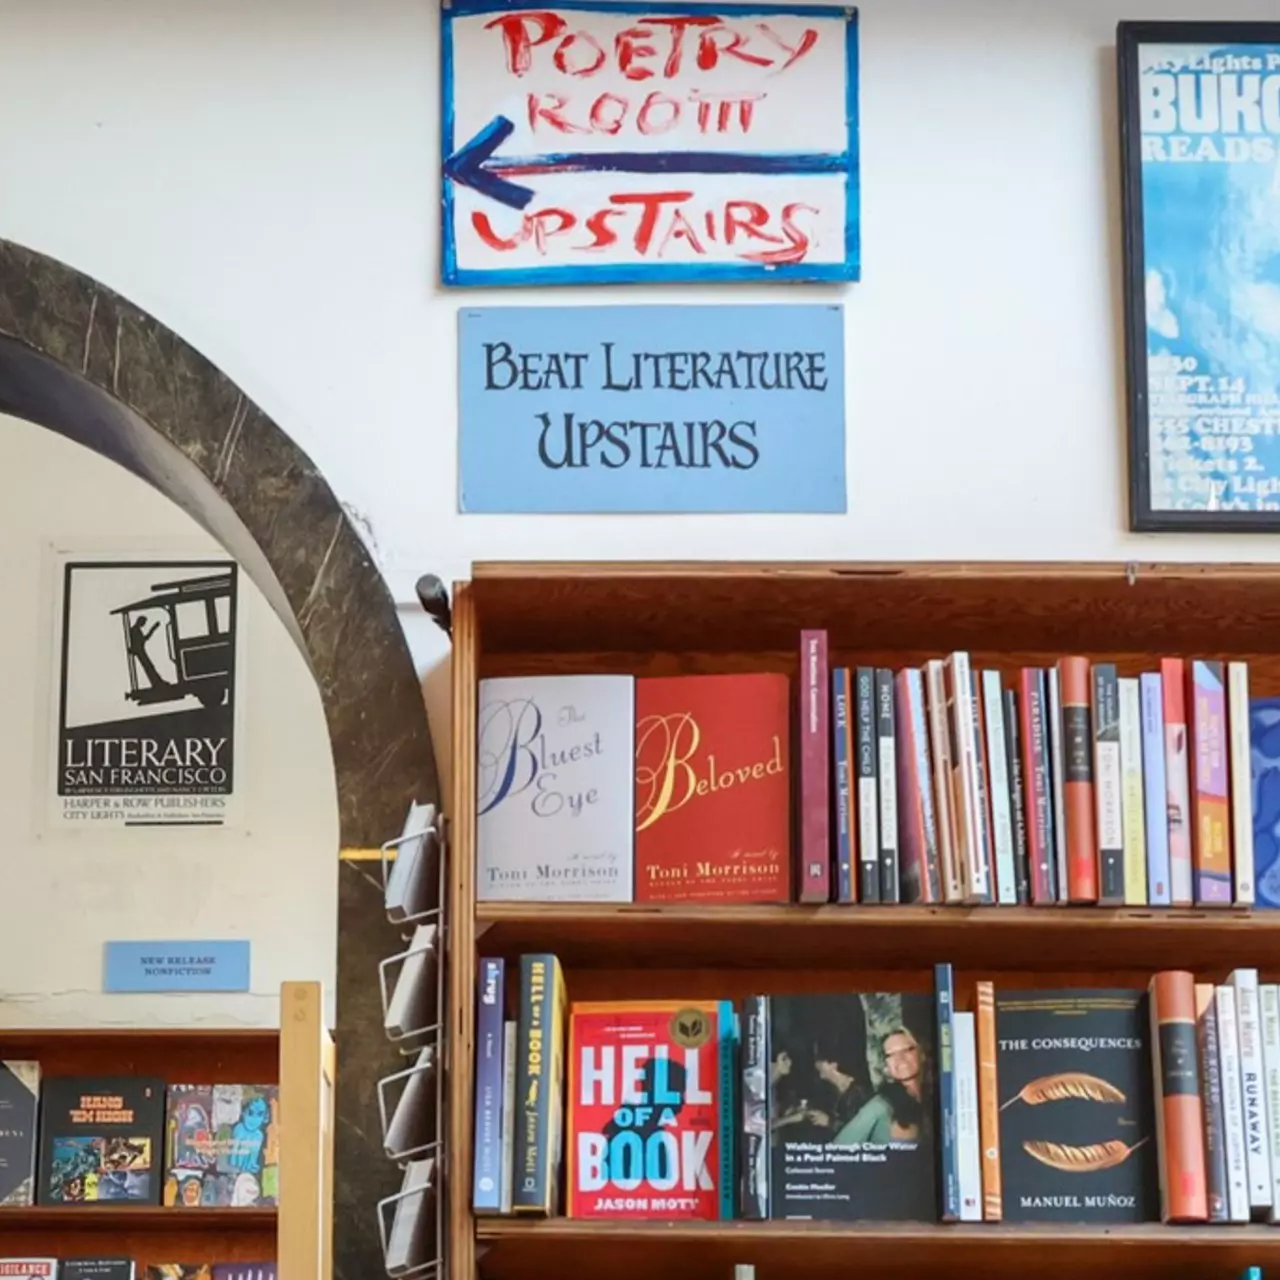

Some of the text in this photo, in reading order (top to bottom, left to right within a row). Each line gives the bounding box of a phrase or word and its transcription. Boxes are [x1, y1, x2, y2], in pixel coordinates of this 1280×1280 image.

[486, 12, 817, 79] POETRY
[1189, 53, 1262, 73] Lights
[528, 89, 766, 135] ROOM
[1141, 135, 1275, 162] READS
[471, 191, 818, 263] UPSTAIRS
[483, 343, 827, 391] BEAT LITERATURE
[1218, 376, 1245, 393] 14
[536, 412, 759, 469] UPSTAIRS
[65, 738, 227, 767] LITERARY
[478, 697, 604, 818] Bluest
[65, 768, 227, 785] SAN FRANCISCO
[636, 711, 784, 832] Beloved
[154, 798, 226, 808] PUBLISHERS
[530, 771, 600, 818] Eye
[487, 864, 618, 881] Toni Morrison
[647, 860, 780, 880] Toni Morrison
[140, 956, 216, 966] NEW RELEASE
[145, 966, 212, 977] NONFICTION
[999, 1037, 1142, 1051] THE CONSEQUENCES
[580, 1045, 712, 1105] HELL
[614, 1107, 678, 1127] OF A
[1245, 1072, 1262, 1155] RUNAWAY
[785, 1142, 918, 1153] Walking through Clear Water
[805, 1153, 823, 1162] Pool
[826, 1153, 860, 1162] Painted
[862, 1153, 887, 1162] Black
[578, 1131, 714, 1191] BOOK
[594, 1197, 699, 1211] JASON MOTT
[1020, 1194, 1135, 1208] MANUEL MUÑOZ
